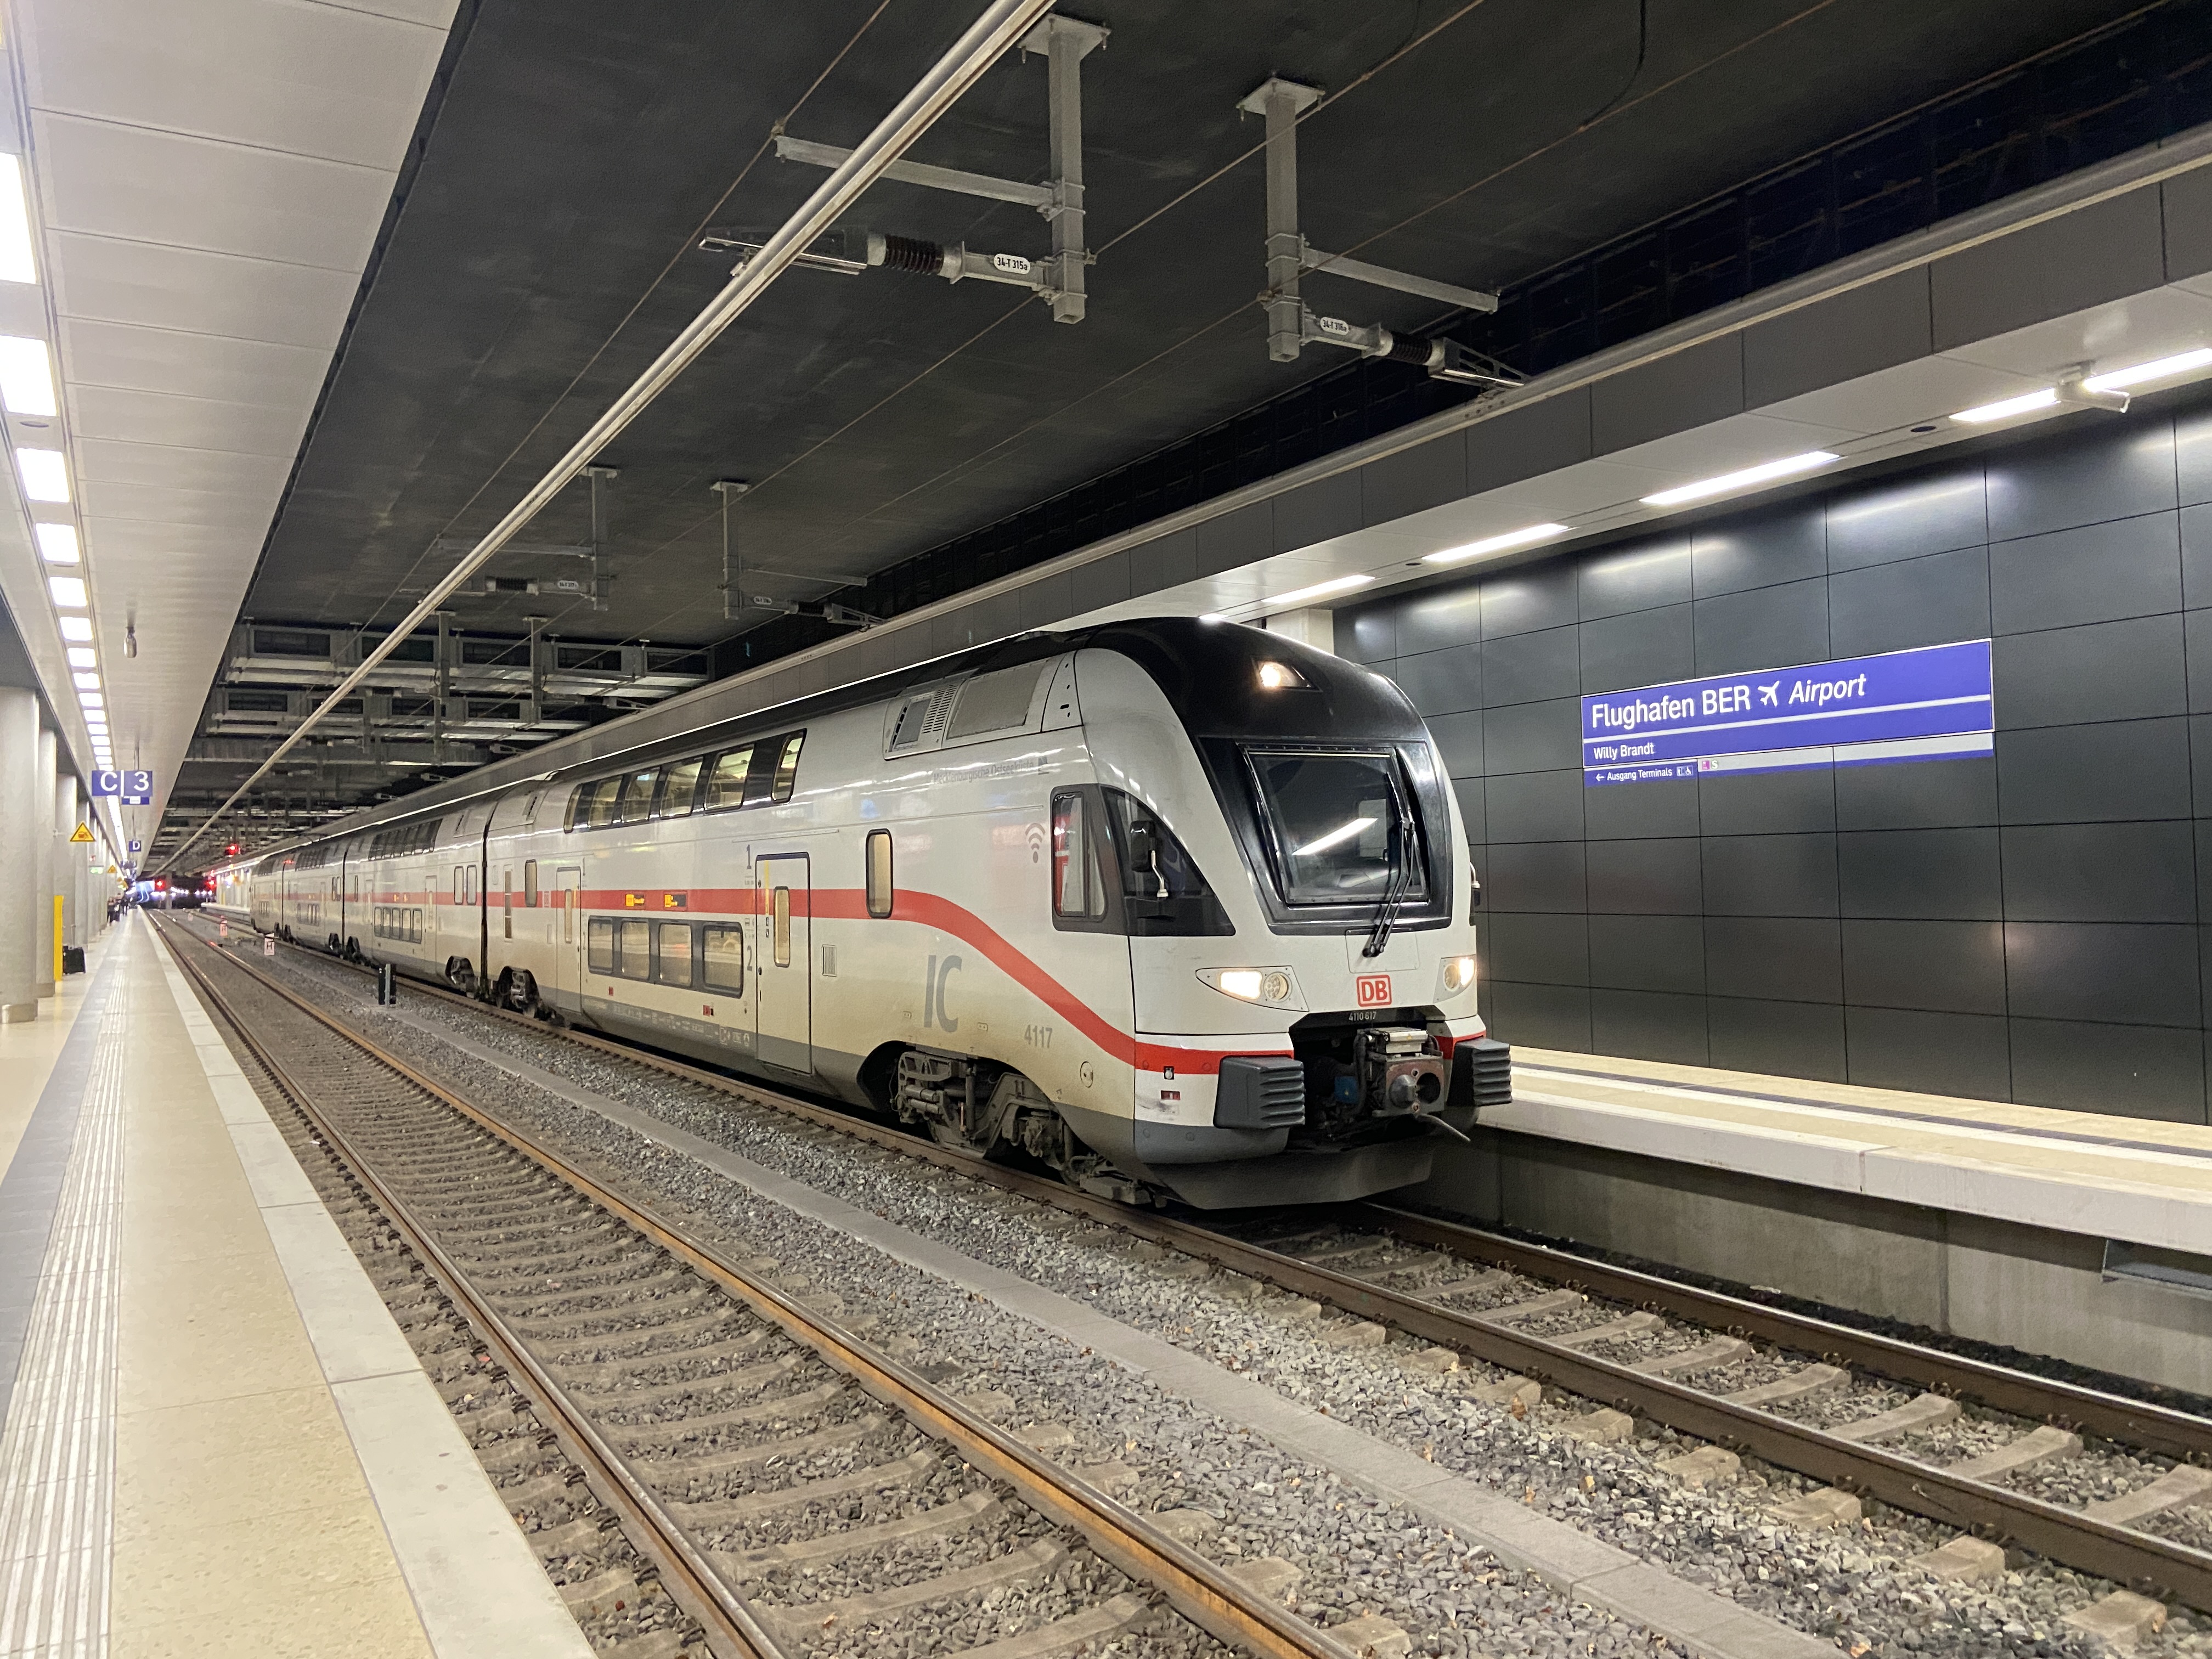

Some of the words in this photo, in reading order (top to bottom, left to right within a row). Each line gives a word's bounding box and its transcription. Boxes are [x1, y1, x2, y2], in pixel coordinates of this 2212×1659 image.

[997, 257, 1011, 268] 34-T
[1012, 260, 1028, 270] 315a
[1592, 695, 1694, 730] Flughafen
[1702, 685, 1751, 715] BER
[1788, 673, 1866, 706] Airport
[1593, 746, 1618, 761] Willy
[1620, 742, 1655, 757] Brandt
[100, 771, 118, 791] C
[134, 771, 149, 791] 3
[1607, 771, 1637, 782] Ausgang
[1638, 768, 1673, 778] Terminals
[132, 841, 140, 850] D
[746, 844, 752, 870] 1
[747, 945, 753, 971] 2
[923, 955, 962, 1033] IC
[1361, 980, 1388, 1002] DB
[1024, 1024, 1053, 1048] 4117
